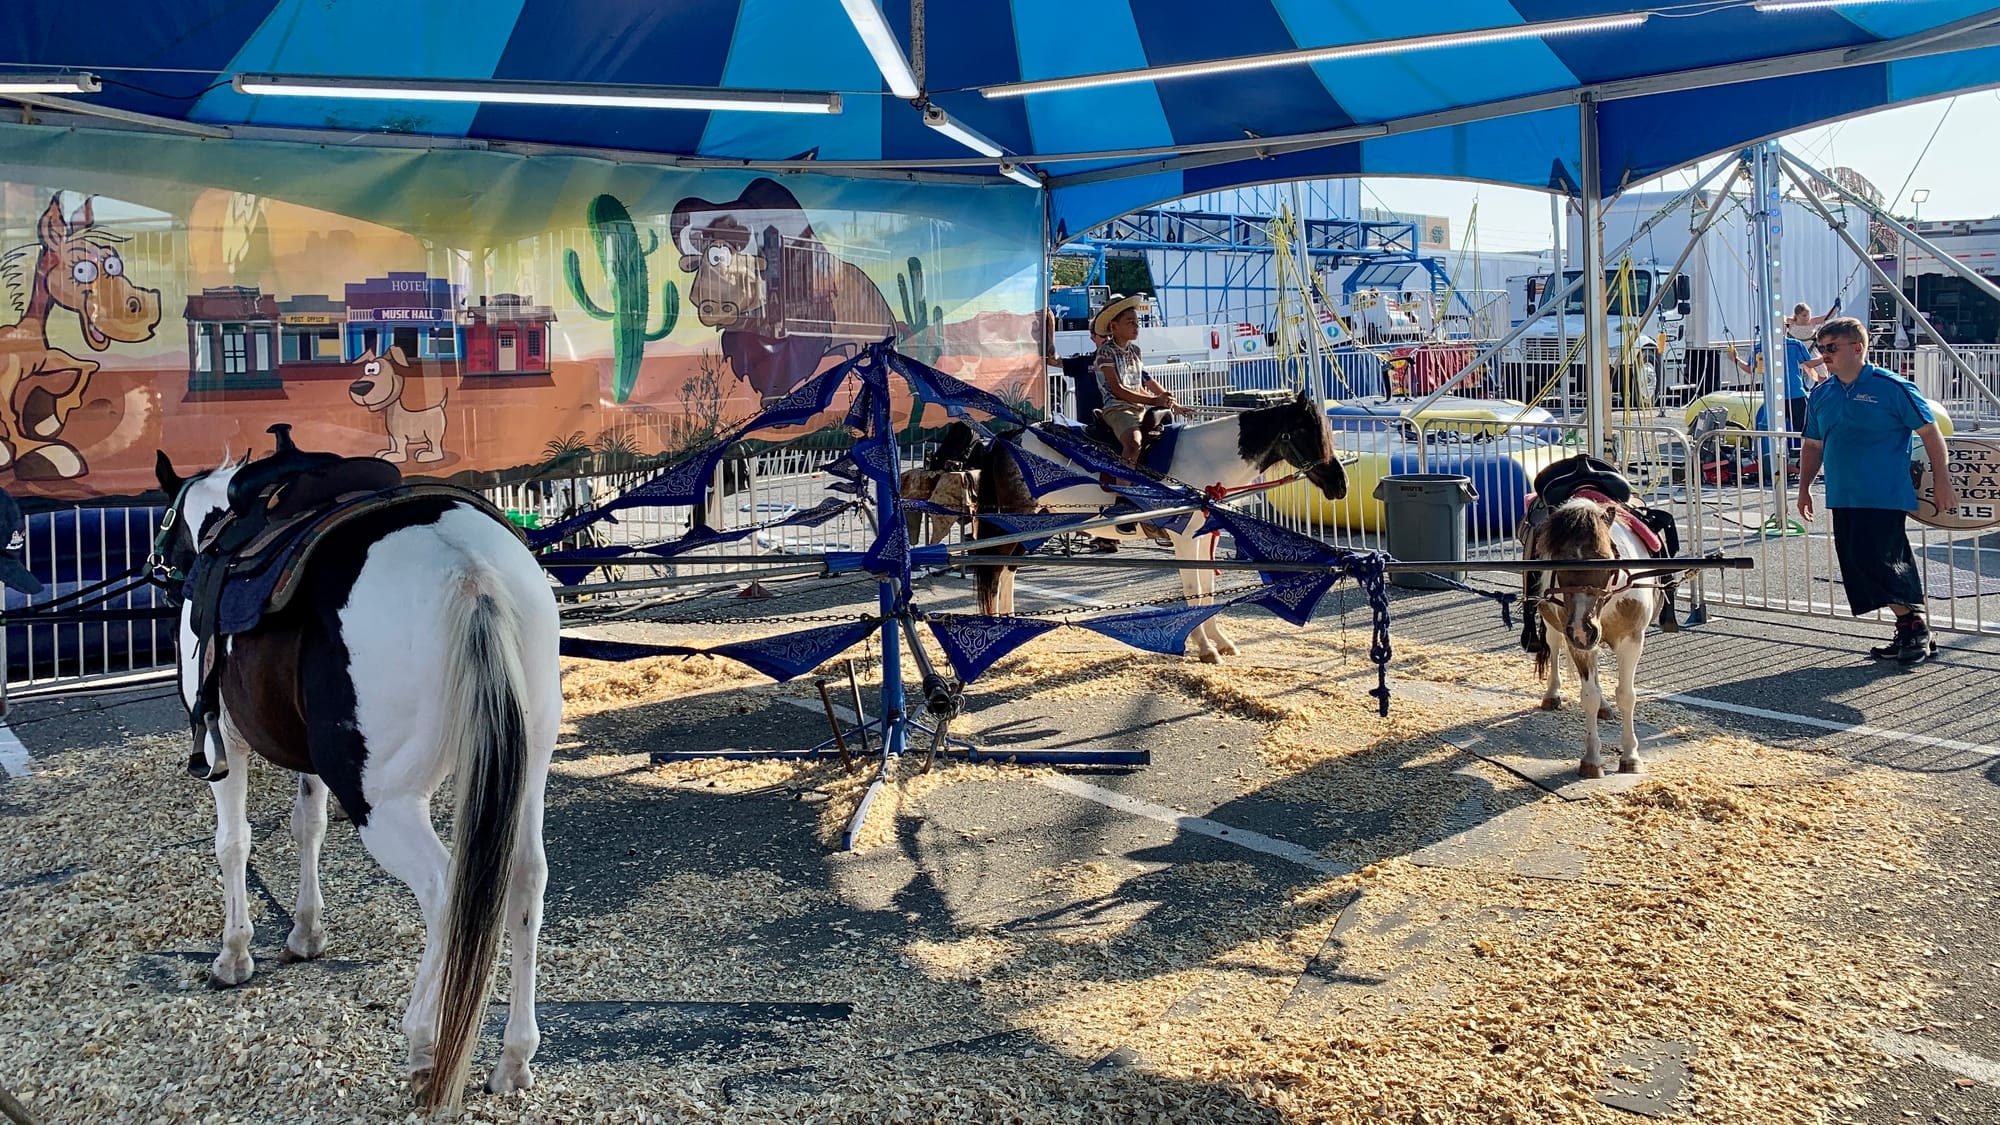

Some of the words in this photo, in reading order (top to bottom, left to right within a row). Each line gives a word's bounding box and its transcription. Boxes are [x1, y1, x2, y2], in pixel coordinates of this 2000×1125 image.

[392, 280, 429, 292] HOTEL
[381, 309, 410, 320] MUSIC
[411, 309, 435, 320] HALL
[1928, 462, 2000, 473] ONY
[1977, 476, 1998, 486] A
[1925, 487, 2000, 499] SICK
[1946, 505, 1992, 518] $15
